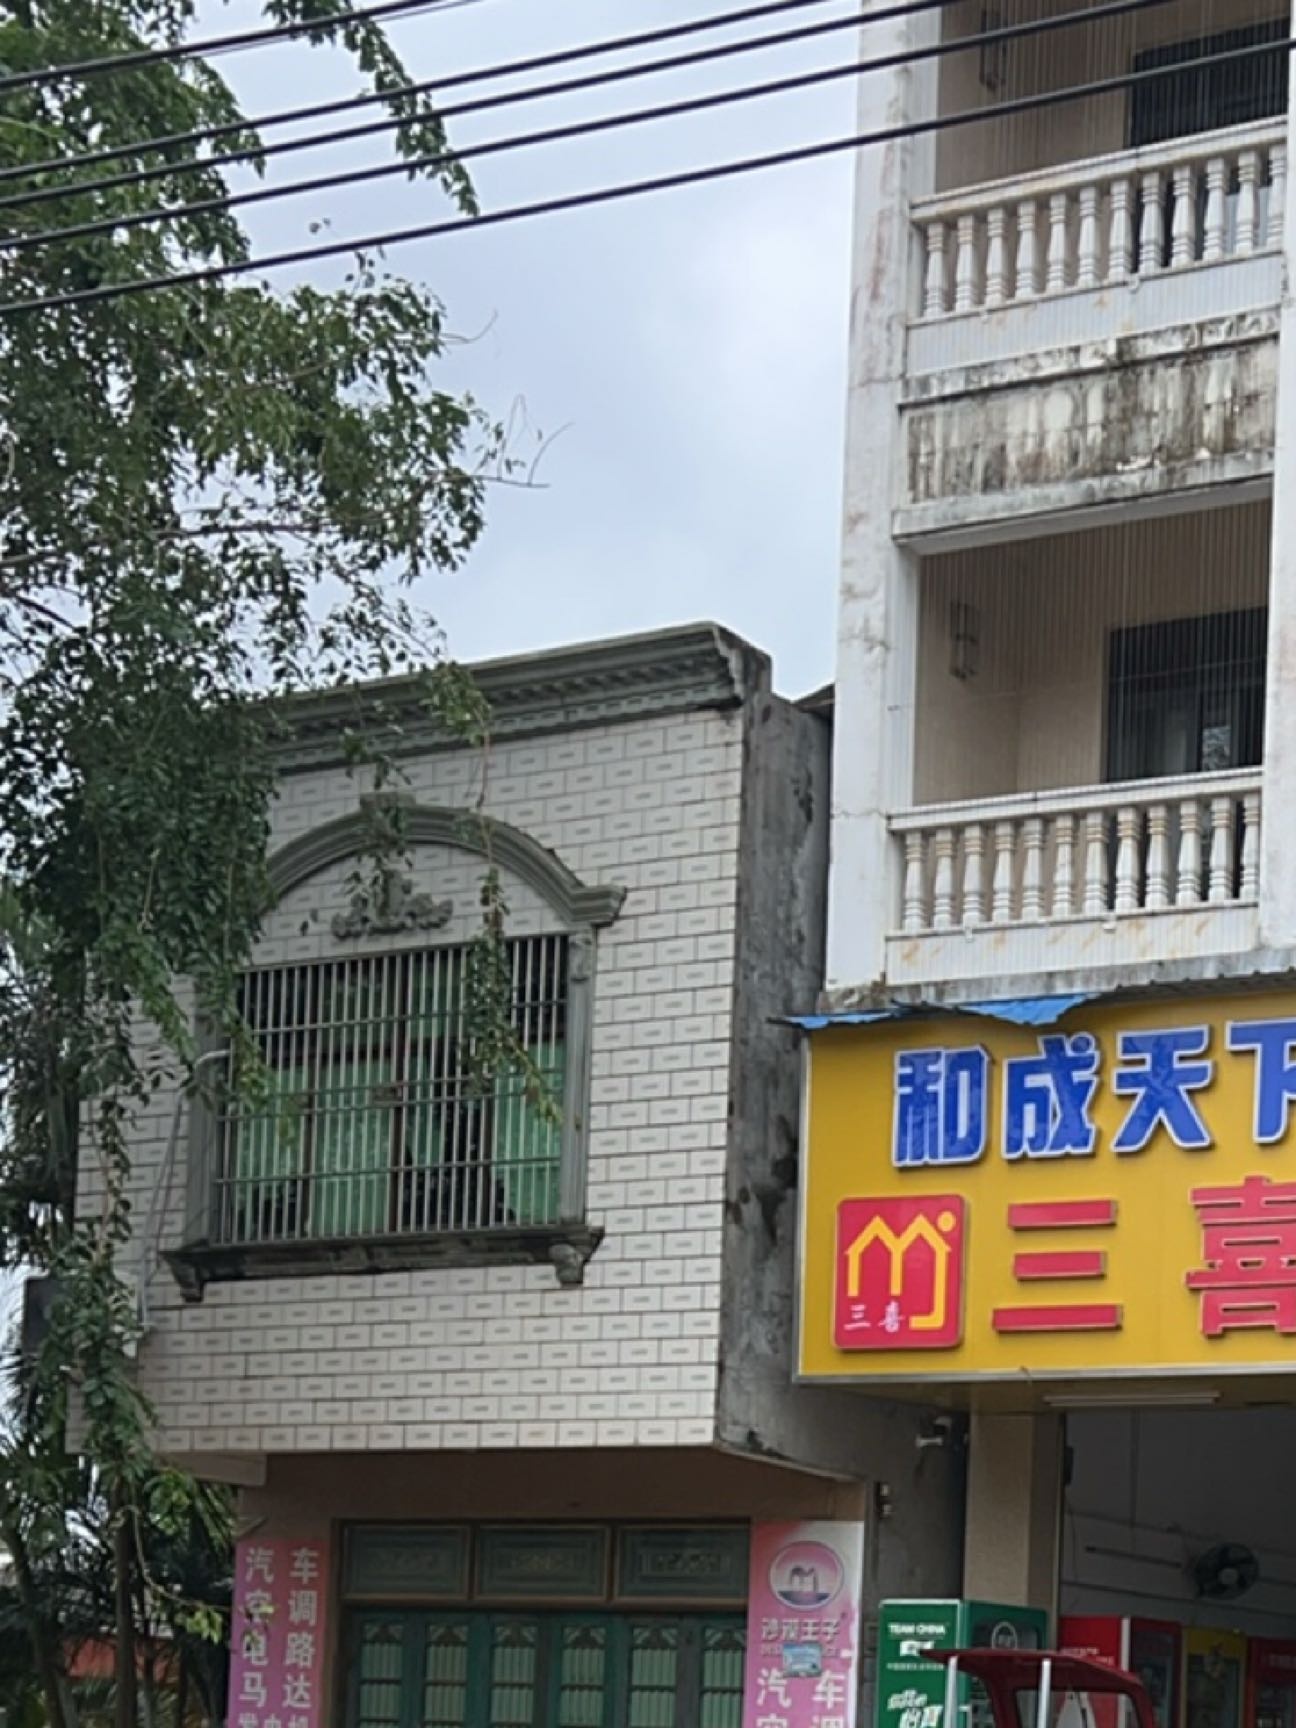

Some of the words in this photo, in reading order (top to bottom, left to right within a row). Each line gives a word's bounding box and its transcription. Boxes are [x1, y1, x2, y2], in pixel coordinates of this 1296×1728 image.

[245, 1547, 319, 1584] 汽车
[244, 1590, 318, 1627] 空调
[242, 1631, 316, 1668] 电路
[239, 1672, 313, 1709] 马达
[757, 1668, 845, 1708] 汽车
